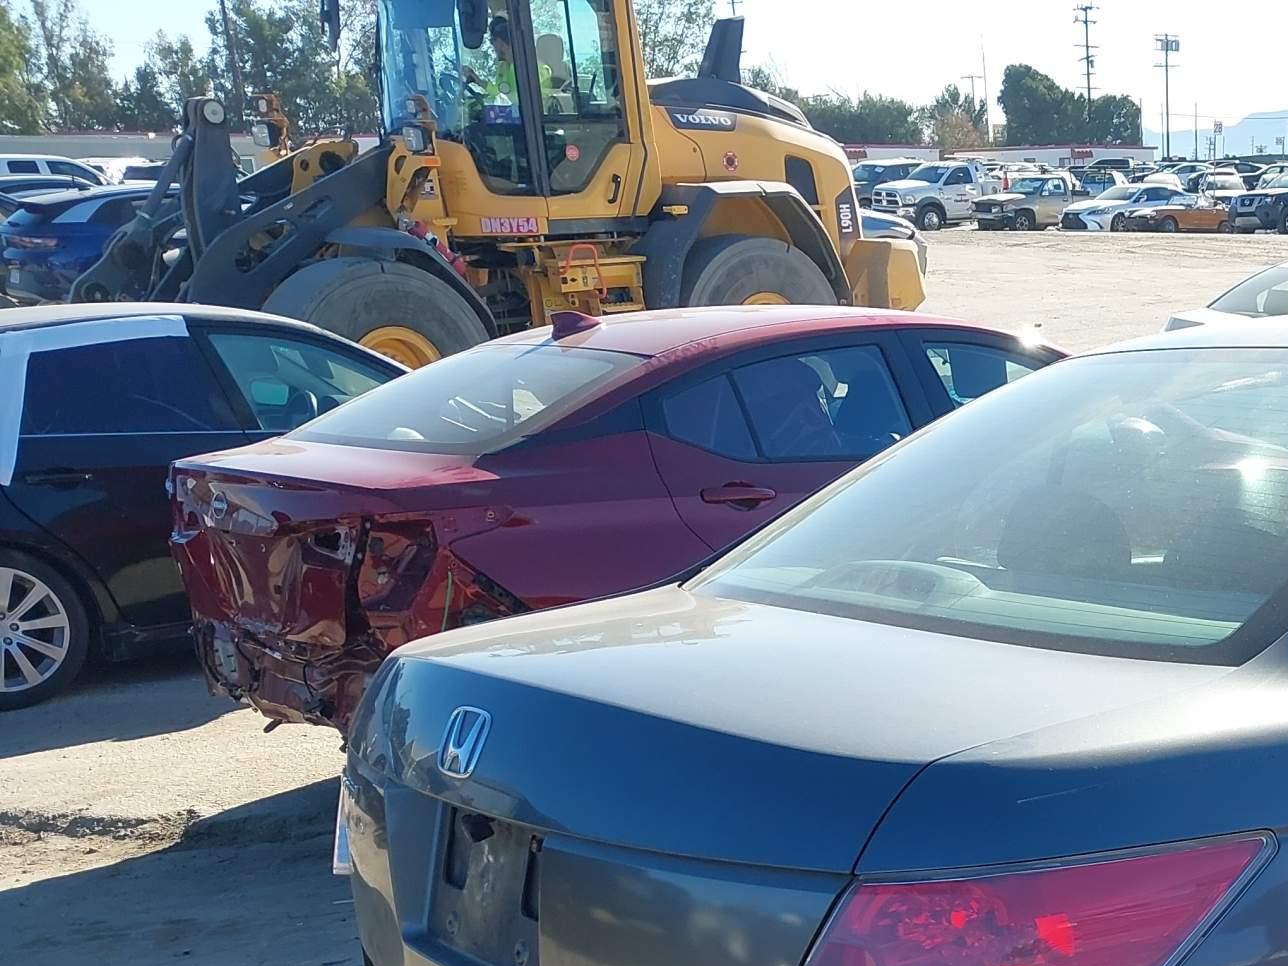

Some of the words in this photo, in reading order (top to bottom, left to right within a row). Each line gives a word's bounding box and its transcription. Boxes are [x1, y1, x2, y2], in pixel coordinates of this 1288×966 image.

[673, 113, 732, 126] VOLVO
[480, 217, 539, 233] DN3Y54
[840, 203, 852, 233] L90H
